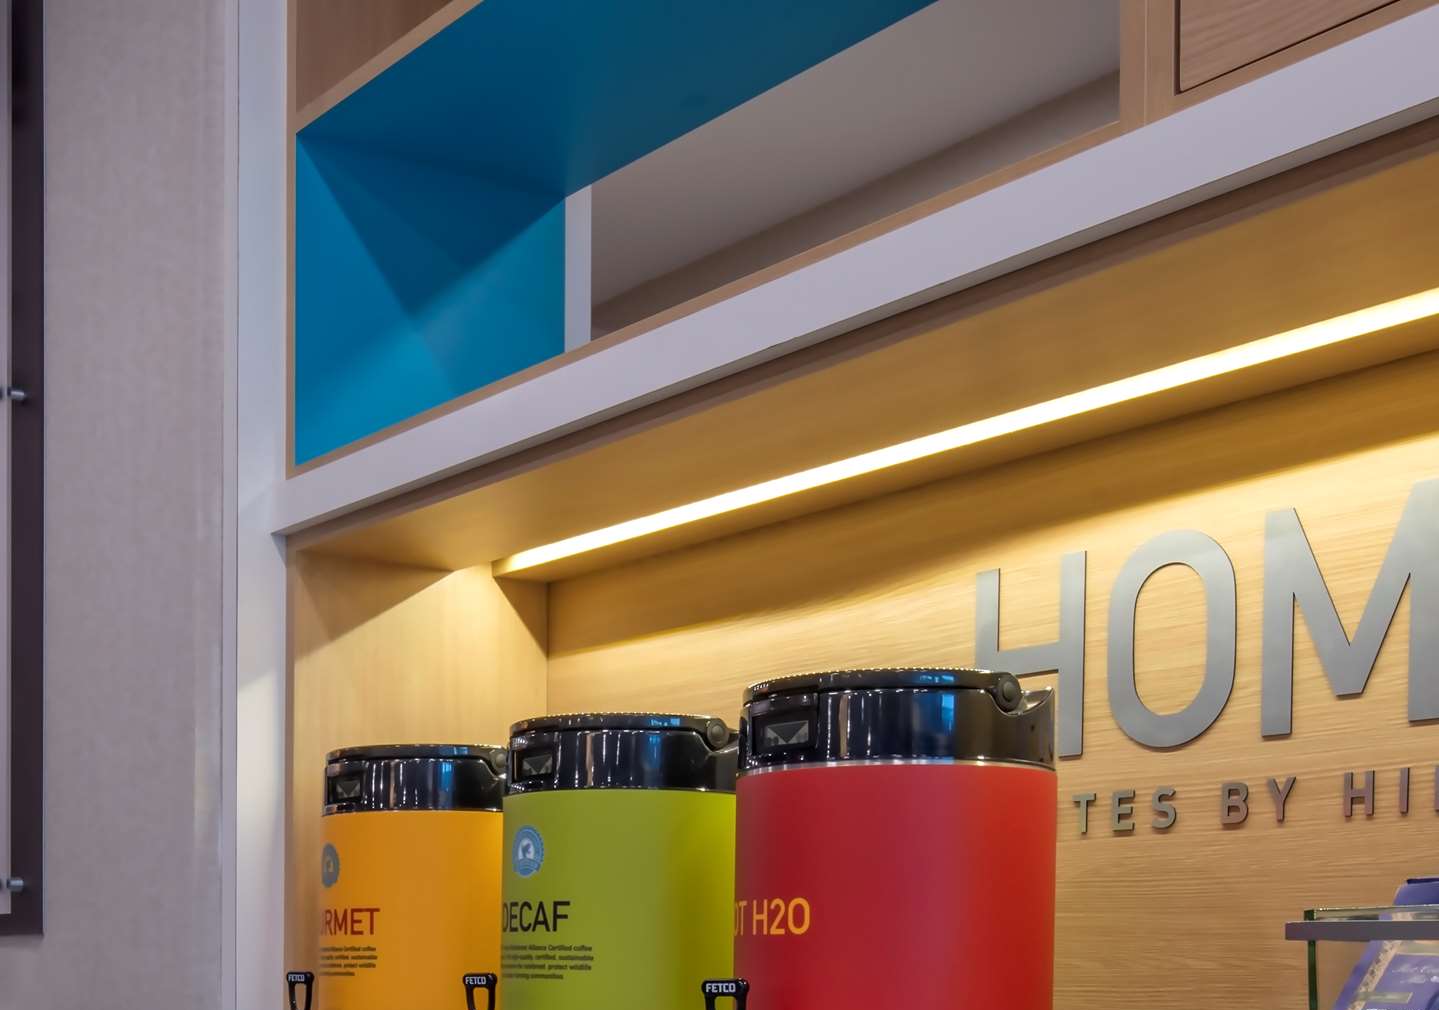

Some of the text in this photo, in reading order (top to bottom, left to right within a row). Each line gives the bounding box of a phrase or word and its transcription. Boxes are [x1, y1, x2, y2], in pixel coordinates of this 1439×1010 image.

[1072, 764, 1439, 835] TES BY HI
[321, 907, 380, 936] RMET
[465, 976, 487, 985] FETCO
[705, 983, 737, 993] FETCO
